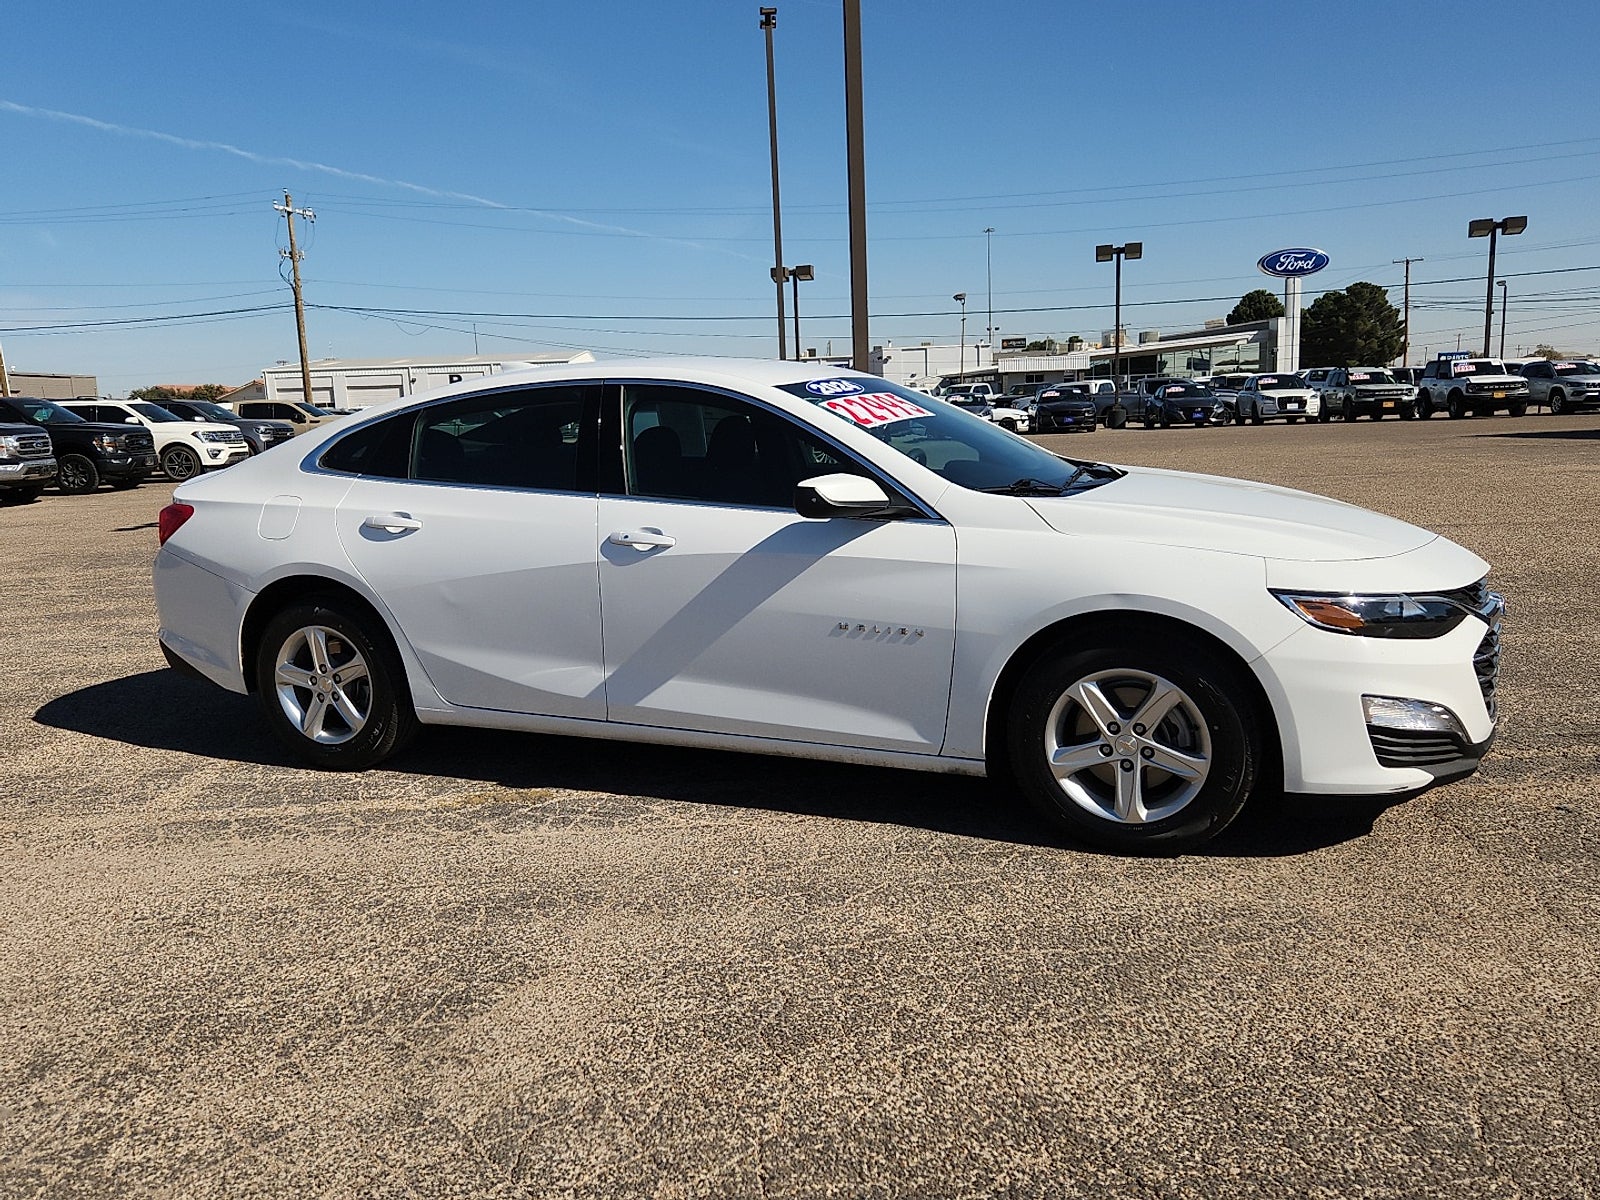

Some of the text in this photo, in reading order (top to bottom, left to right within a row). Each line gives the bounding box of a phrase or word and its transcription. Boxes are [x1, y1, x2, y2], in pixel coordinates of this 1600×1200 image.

[1275, 253, 1317, 271] Ford
[808, 379, 862, 395] 2024
[826, 393, 926, 425] 22995
